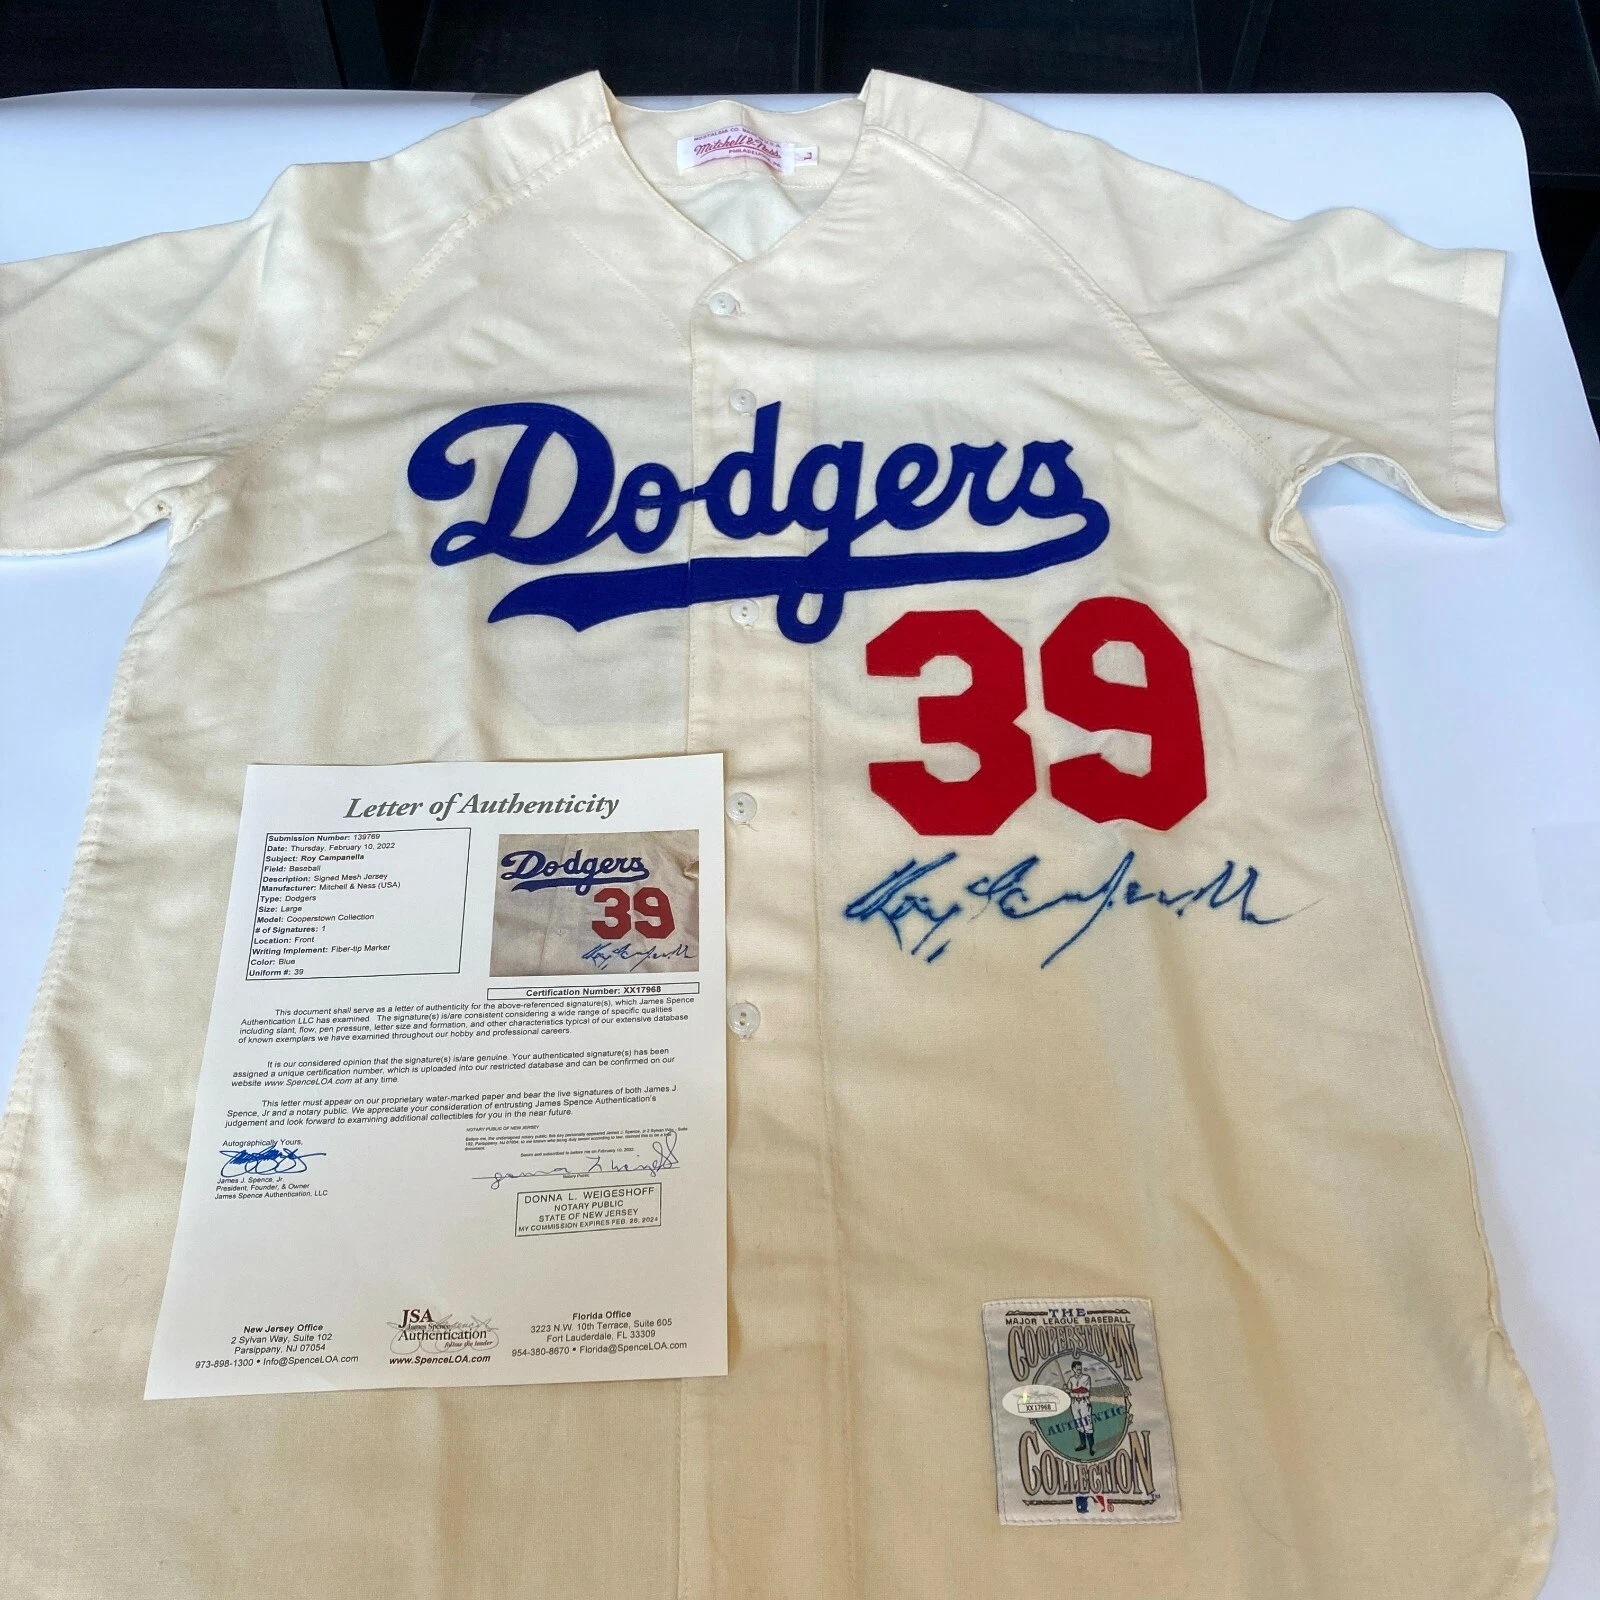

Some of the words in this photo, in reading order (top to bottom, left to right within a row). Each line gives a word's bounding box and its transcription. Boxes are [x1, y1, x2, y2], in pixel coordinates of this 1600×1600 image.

[694, 135, 747, 156] Mitchell
[747, 137, 756, 145] &
[408, 401, 1109, 644] Dodgers
[866, 597, 1208, 836] 39
[343, 797, 423, 819] Letter
[429, 792, 463, 821] of
[457, 792, 620, 819] Authenticity
[267, 834, 315, 842] Submission
[316, 834, 350, 842] Number:
[266, 844, 288, 852] Date:
[290, 844, 326, 852] Thursday,
[363, 842, 375, 850] 10,
[376, 841, 396, 850] 2022
[265, 855, 298, 863] Subject:
[300, 854, 317, 863] Roy
[317, 853, 364, 862] Campanella
[288, 864, 321, 872] Baseball
[501, 849, 650, 896] Dodgers
[262, 875, 311, 883] Description:
[313, 874, 340, 883] Signed
[340, 873, 362, 881] Mesh
[362, 873, 388, 881] Jersey
[260, 884, 316, 892] Manufacturer:
[318, 882, 348, 891] Mitchell
[348, 882, 355, 890] &
[377, 881, 401, 890] (USA)
[259, 895, 282, 904] Type:
[284, 894, 317, 903] Dodgers
[258, 905, 278, 913] Size:
[280, 905, 302, 913] Large
[591, 886, 676, 939] 39
[256, 915, 284, 924] Model:
[286, 915, 336, 923] Cooperstown
[337, 913, 374, 921] Collection
[254, 926, 261, 934] #
[261, 926, 272, 934] of
[271, 926, 318, 934] Signatures:
[321, 924, 326, 932] 1
[253, 937, 292, 945] Location:
[251, 947, 281, 956] Writing
[282, 946, 328, 955] Implement:
[330, 945, 362, 953] Fiber-tip
[363, 944, 391, 952] Marker
[250, 958, 275, 966] Color:
[278, 957, 296, 965] Blue
[248, 968, 282, 977] Uniform
[293, 968, 304, 976] 39
[525, 988, 580, 997] Certification
[582, 987, 620, 995] Number:
[622, 985, 661, 994] XX17968
[266, 1060, 273, 1068] It
[273, 1060, 281, 1068] is
[297, 1058, 342, 1068] considered
[342, 1058, 372, 1067] opinion
[373, 1056, 389, 1065] that
[390, 1056, 403, 1065] the
[404, 1055, 451, 1065] signature(s)
[452, 1054, 475, 1062] is/are
[475, 1053, 509, 1063] genuine.
[511, 1052, 531, 1061] Your
[531, 1050, 585, 1060] authenticated
[585, 1048, 632, 1059] signature(s)
[633, 1048, 648, 1056] has
[649, 1047, 669, 1055] been
[230, 1079, 262, 1087] website
[264, 1076, 353, 1087] www.SpenceLOA.com
[353, 1076, 363, 1084] at
[363, 1077, 379, 1085] any
[221, 1138, 279, 1148] Autographically
[216, 1177, 239, 1185] James
[250, 1183, 280, 1191] Founder,
[287, 1182, 310, 1190] Owner
[213, 1192, 237, 1200] James
[237, 1191, 263, 1200] Spence
[263, 1190, 312, 1198] Authentication,
[313, 1189, 328, 1197] LLC
[524, 1193, 563, 1204] DONNA
[568, 1192, 577, 1201] L.
[582, 1186, 654, 1200] WEIGESHOFF
[553, 1201, 590, 1212] NOTARY
[591, 1199, 624, 1209] PUBLIC
[538, 1213, 566, 1223] STATE
[567, 1211, 580, 1220] OF
[581, 1210, 603, 1219] NEW
[604, 1207, 639, 1218] JERSEY
[530, 1221, 578, 1232] COMMISSION
[579, 1219, 610, 1228] EXPIRES
[398, 1308, 435, 1329] JSA
[571, 1311, 603, 1321] Florida
[605, 1309, 632, 1319] Office
[1049, 1308, 1087, 1318] THE
[530, 1323, 552, 1334] 3223
[576, 1321, 595, 1331] 10th
[596, 1320, 630, 1330] Terrace,
[633, 1319, 655, 1328] Suite
[656, 1317, 673, 1327] 605
[1005, 1317, 1038, 1326] MAJOR
[1043, 1316, 1079, 1325] LEAGUE
[1084, 1316, 1131, 1325] BASEBALL
[242, 1325, 264, 1334] New
[264, 1324, 295, 1334] Jersey
[296, 1323, 324, 1332] Office
[398, 1328, 487, 1341] Authentication
[230, 1335, 237, 1345] 2
[238, 1335, 267, 1346] Sylvan
[269, 1334, 290, 1344] Way,
[292, 1333, 315, 1342] Suite
[316, 1332, 333, 1341] 102
[545, 1333, 563, 1343] Fort
[565, 1331, 613, 1342] Lauderdale,
[616, 1330, 628, 1339] FL
[629, 1328, 656, 1339] 33309
[233, 1345, 283, 1355] Parsippany,
[285, 1343, 298, 1352] NJ
[299, 1342, 326, 1352] 07054
[511, 1345, 570, 1357] 954-380-8670
[579, 1340, 687, 1354] Florida@SpenceLOA.com
[1008, 1324, 1143, 1382] COOPERSTOWN
[194, 1358, 254, 1369] 973-898-1300
[262, 1354, 359, 1367] Info@SpenceLOA.com
[389, 1354, 491, 1366] www.SpenceLOA.com
[1025, 1404, 1052, 1412] XX17968
[1047, 1406, 1125, 1437] AUTHENTIC
[1018, 1430, 1156, 1496] COLLECTION
